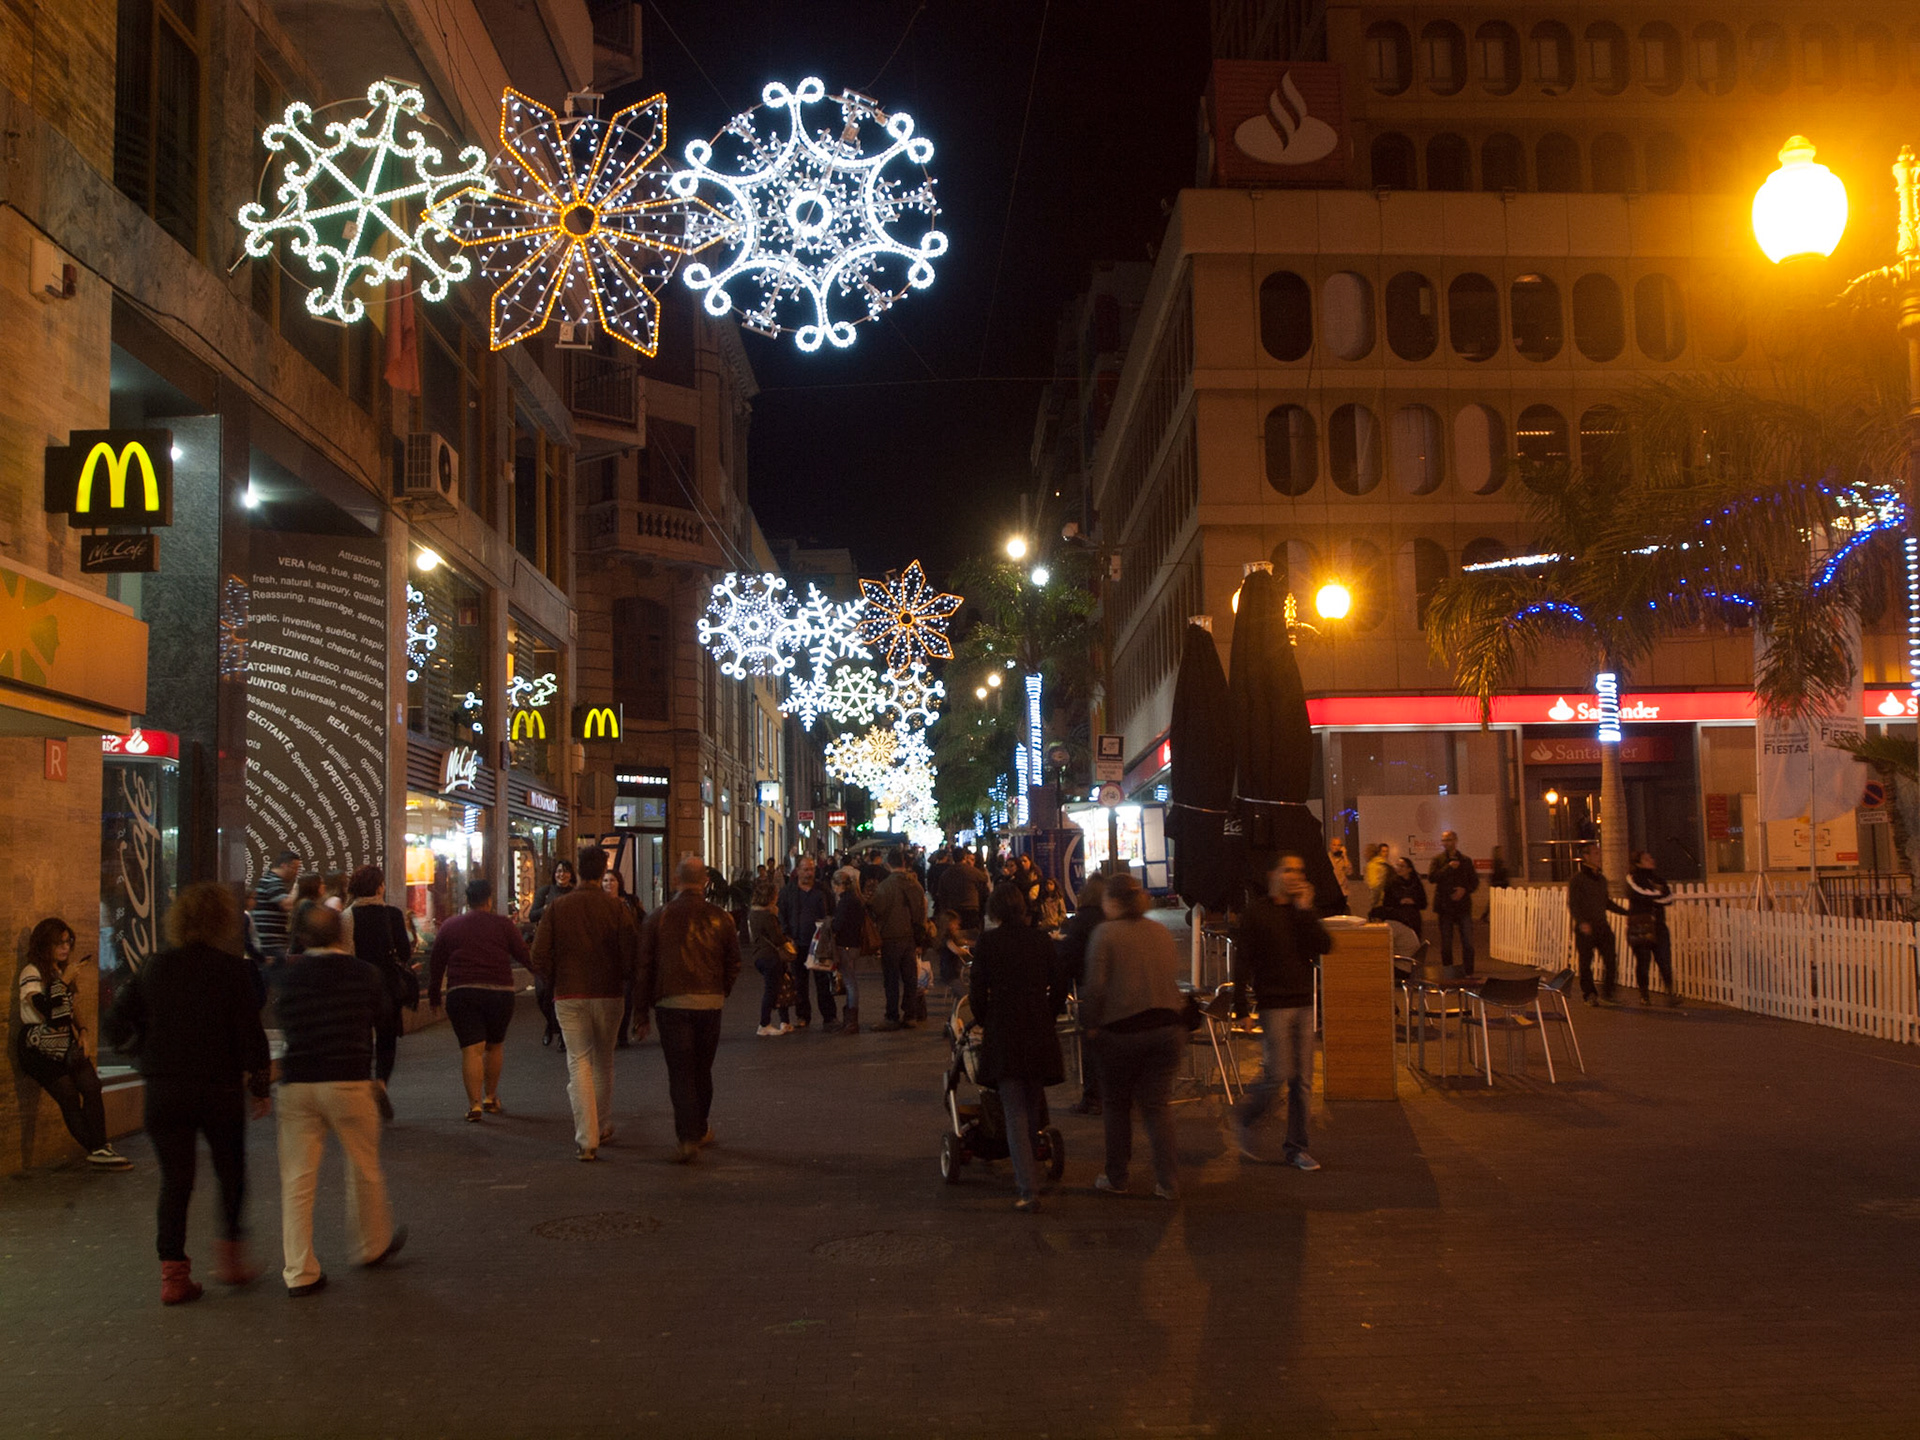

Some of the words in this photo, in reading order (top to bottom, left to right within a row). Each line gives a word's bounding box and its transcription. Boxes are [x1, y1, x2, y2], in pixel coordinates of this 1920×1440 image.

[278, 556, 306, 569] VERA
[307, 561, 329, 575] fede,
[331, 567, 351, 580] true,
[352, 573, 382, 589] strong,
[338, 549, 384, 570] Attrazione,
[252, 573, 279, 586] fresh,
[280, 577, 314, 589] natural,
[315, 581, 352, 597] savoury,
[353, 590, 385, 607] qualitat
[252, 590, 306, 604] Reassuring,
[307, 596, 356, 618] maternage,
[281, 627, 325, 648] Universal,
[326, 641, 362, 663] cheerful,
[282, 614, 324, 632] inventive,
[325, 626, 359, 642] sueños,
[250, 640, 311, 664] APPETIZING,
[312, 655, 342, 674] fresco,
[246, 675, 289, 695] JUNTOS,
[290, 686, 338, 710] Universale,
[339, 704, 373, 729] cheerful,
[294, 669, 338, 689] Attraction,
[340, 683, 370, 704] energy,
[326, 714, 352, 738] REAL,
[51, 744, 63, 776] R
[245, 738, 262, 750] ots
[1555, 743, 1639, 761] Santaer
[246, 709, 295, 754] EXCITANTE,
[290, 751, 320, 793] Spectacle,
[317, 791, 338, 822] upbeat,
[334, 821, 350, 851] magia,
[288, 714, 328, 748] seguridad,
[325, 743, 353, 774] familiar,
[348, 772, 380, 818] prospecting
[373, 818, 384, 854] comfort,
[360, 757, 384, 796] optimism,
[445, 745, 478, 794] McCafé
[262, 769, 290, 795] energy,
[290, 791, 307, 810] vivo,
[305, 808, 336, 860] enlightening,
[263, 794, 299, 833] qualitative,
[320, 760, 360, 816] APPETITOSO,
[355, 816, 371, 853] affresco,
[258, 808, 289, 843] inspiring,
